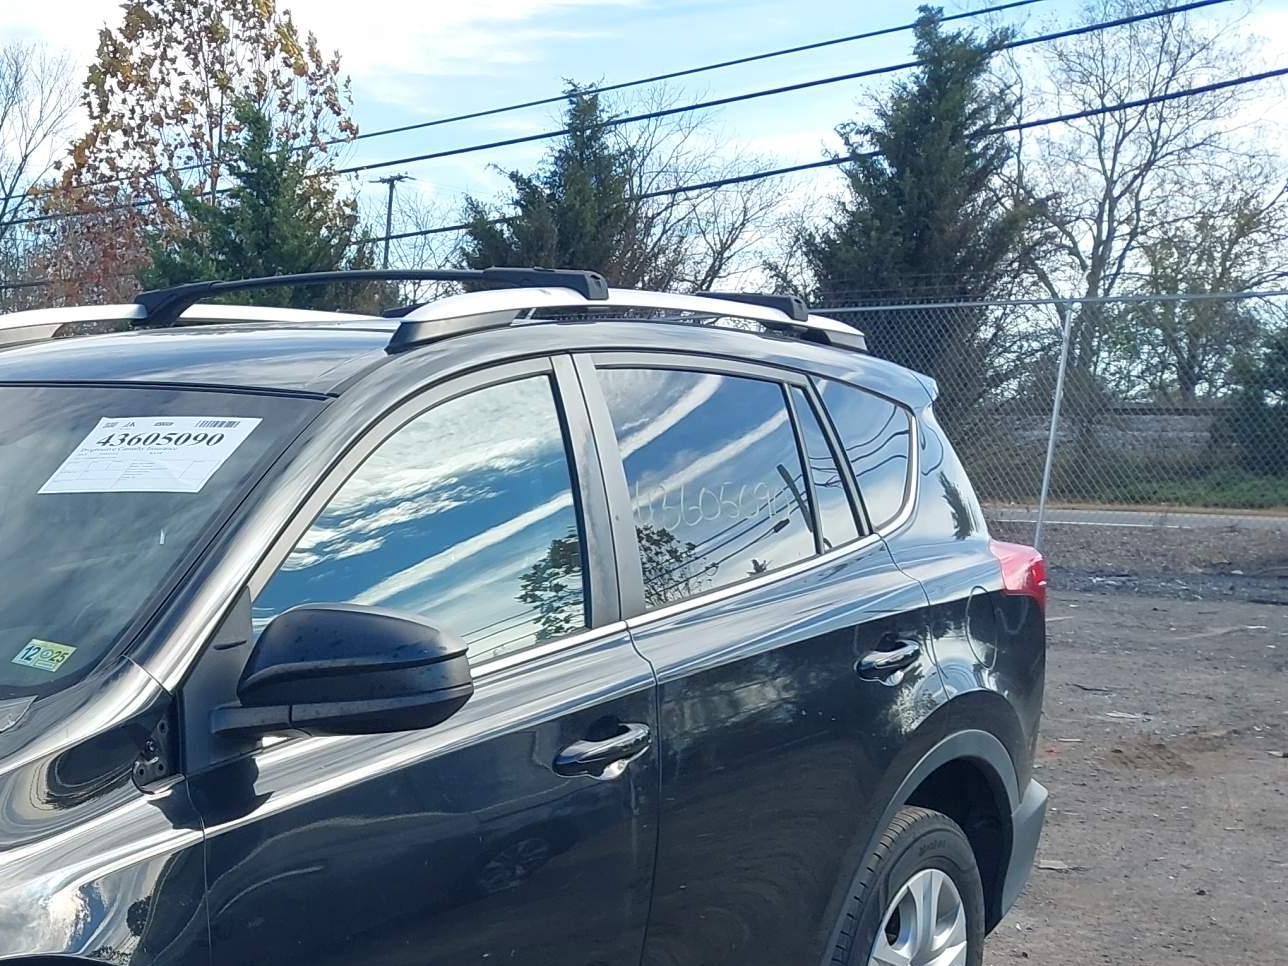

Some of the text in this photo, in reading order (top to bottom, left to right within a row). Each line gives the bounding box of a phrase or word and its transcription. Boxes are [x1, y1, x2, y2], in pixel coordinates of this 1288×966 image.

[96, 432, 225, 448] 43605090
[20, 645, 42, 662] 12
[50, 650, 69, 664] 25
